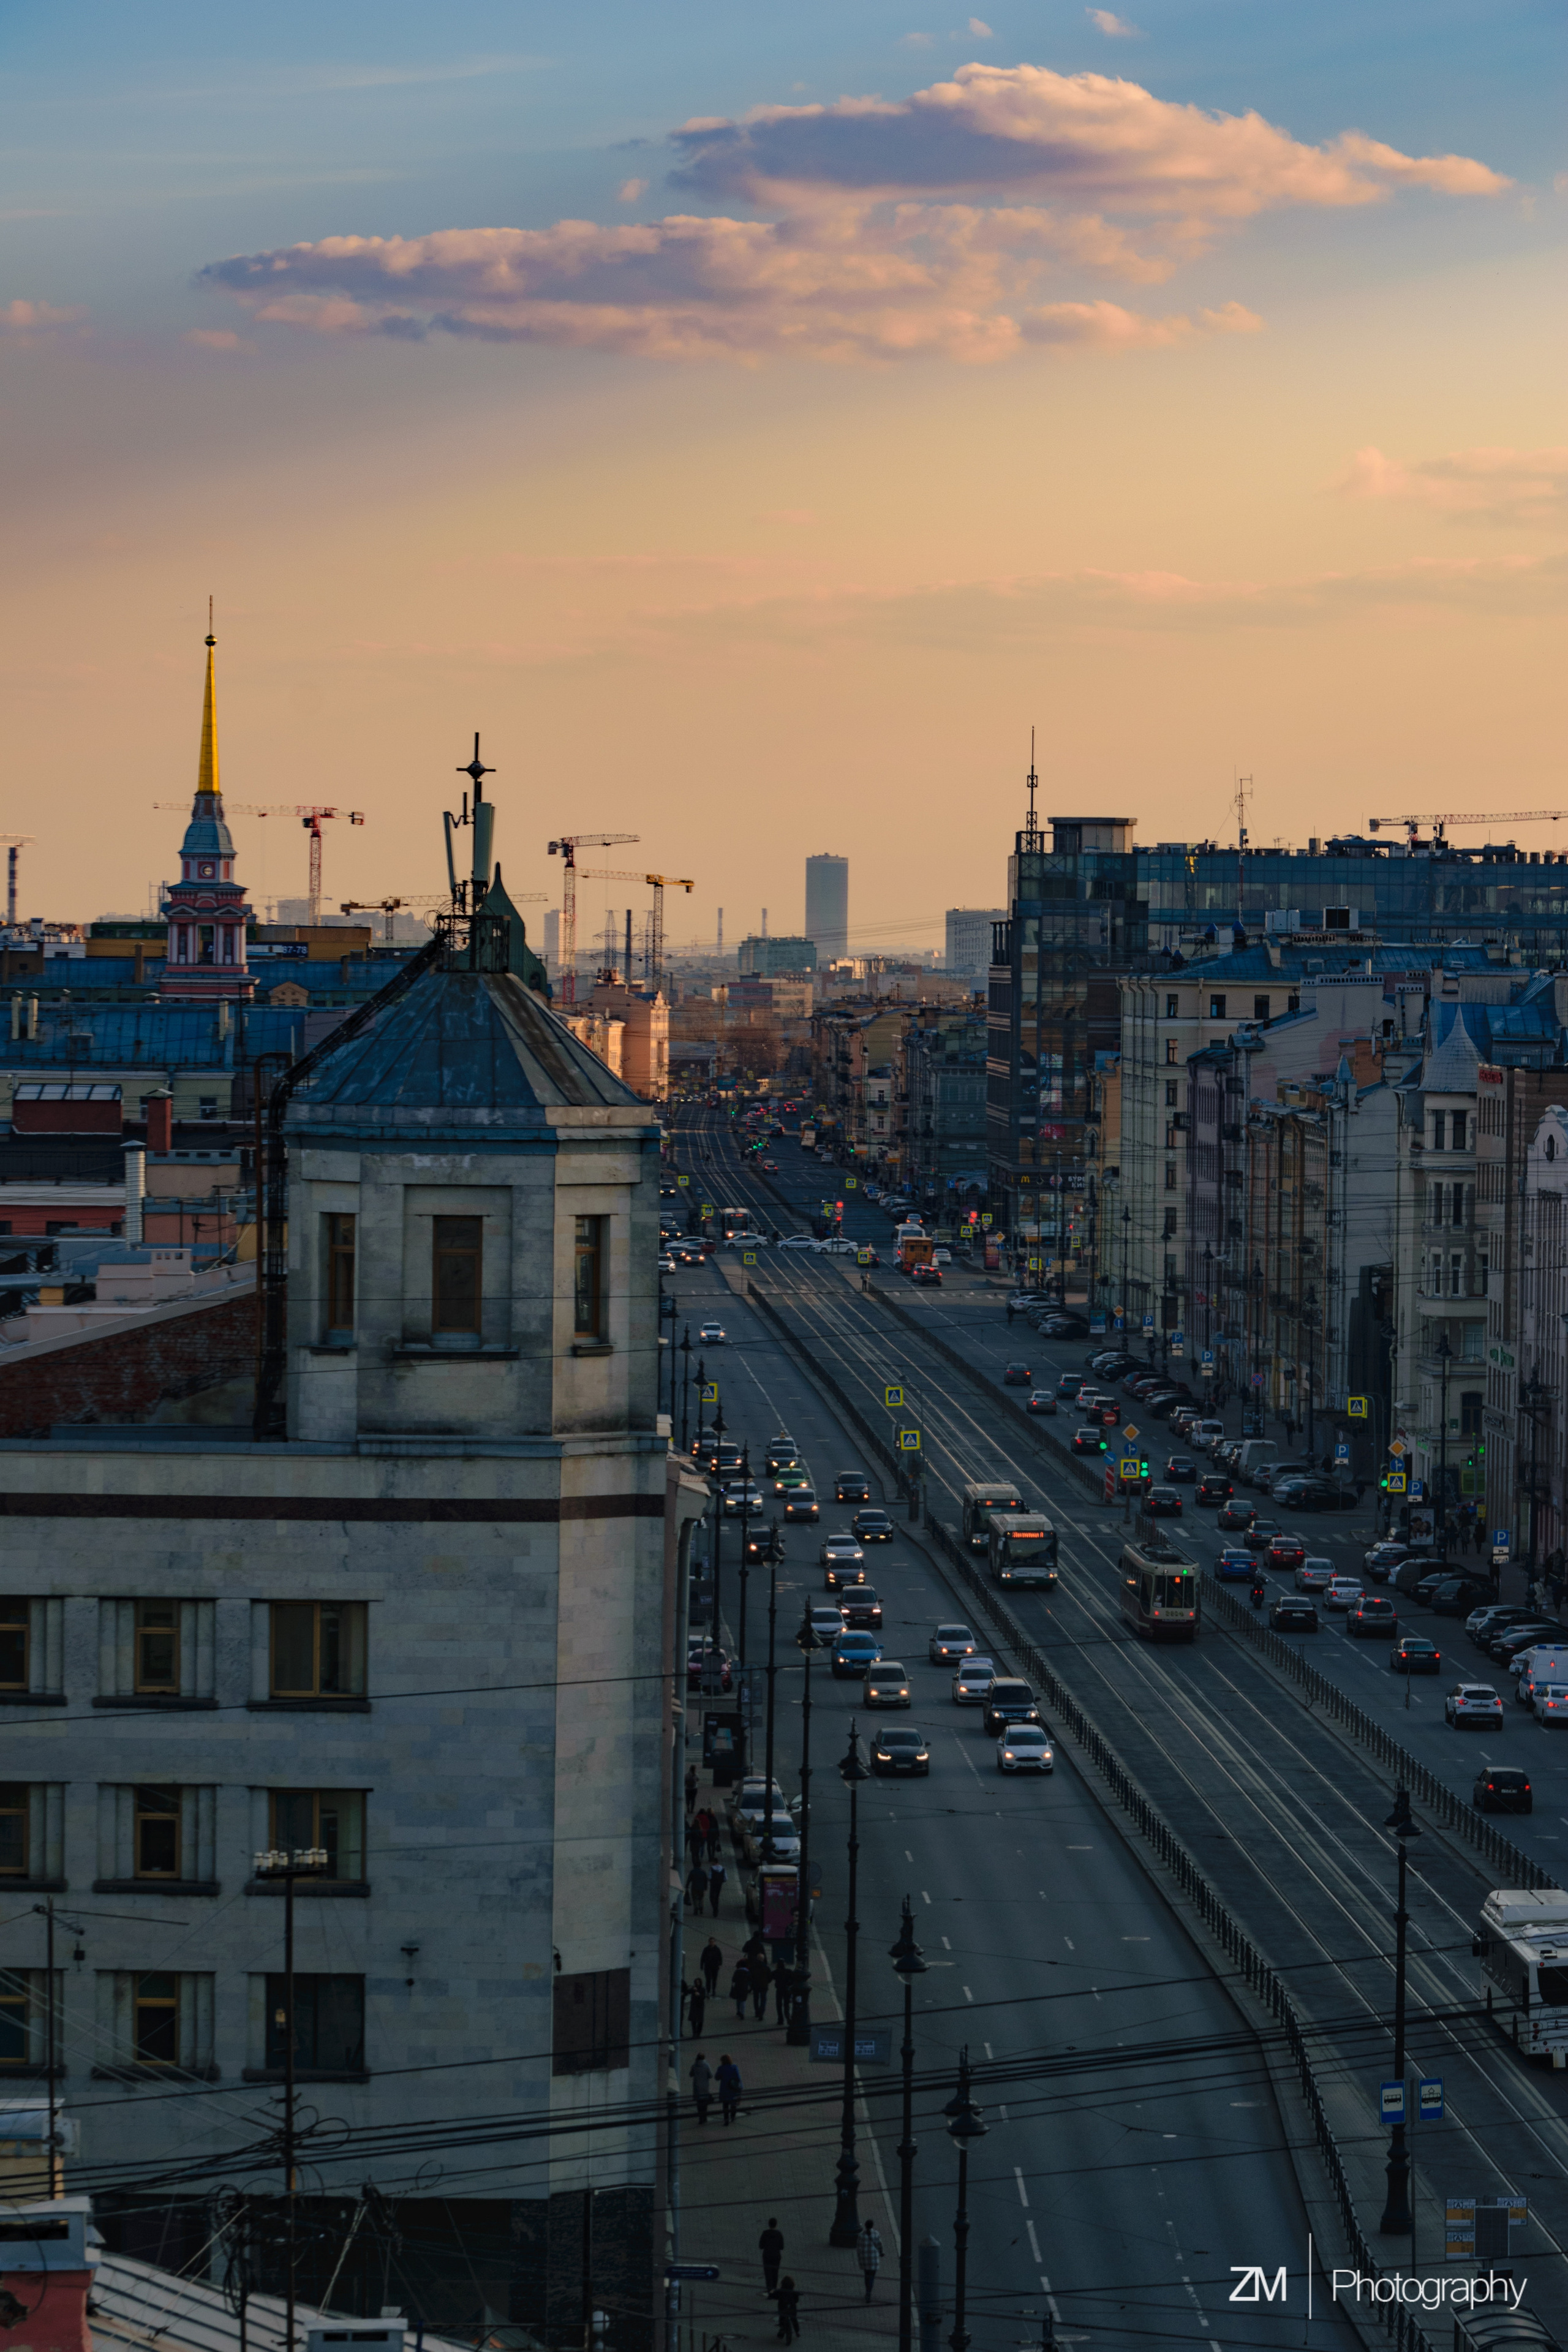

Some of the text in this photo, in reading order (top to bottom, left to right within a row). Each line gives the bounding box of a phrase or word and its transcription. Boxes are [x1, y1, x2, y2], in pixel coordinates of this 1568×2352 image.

[1145, 1316, 1152, 1325] P
[1204, 1352, 1211, 1361] P
[1338, 1445, 1346, 1456] P
[1411, 1482, 1420, 1493] P
[1497, 1531, 1506, 1544] P
